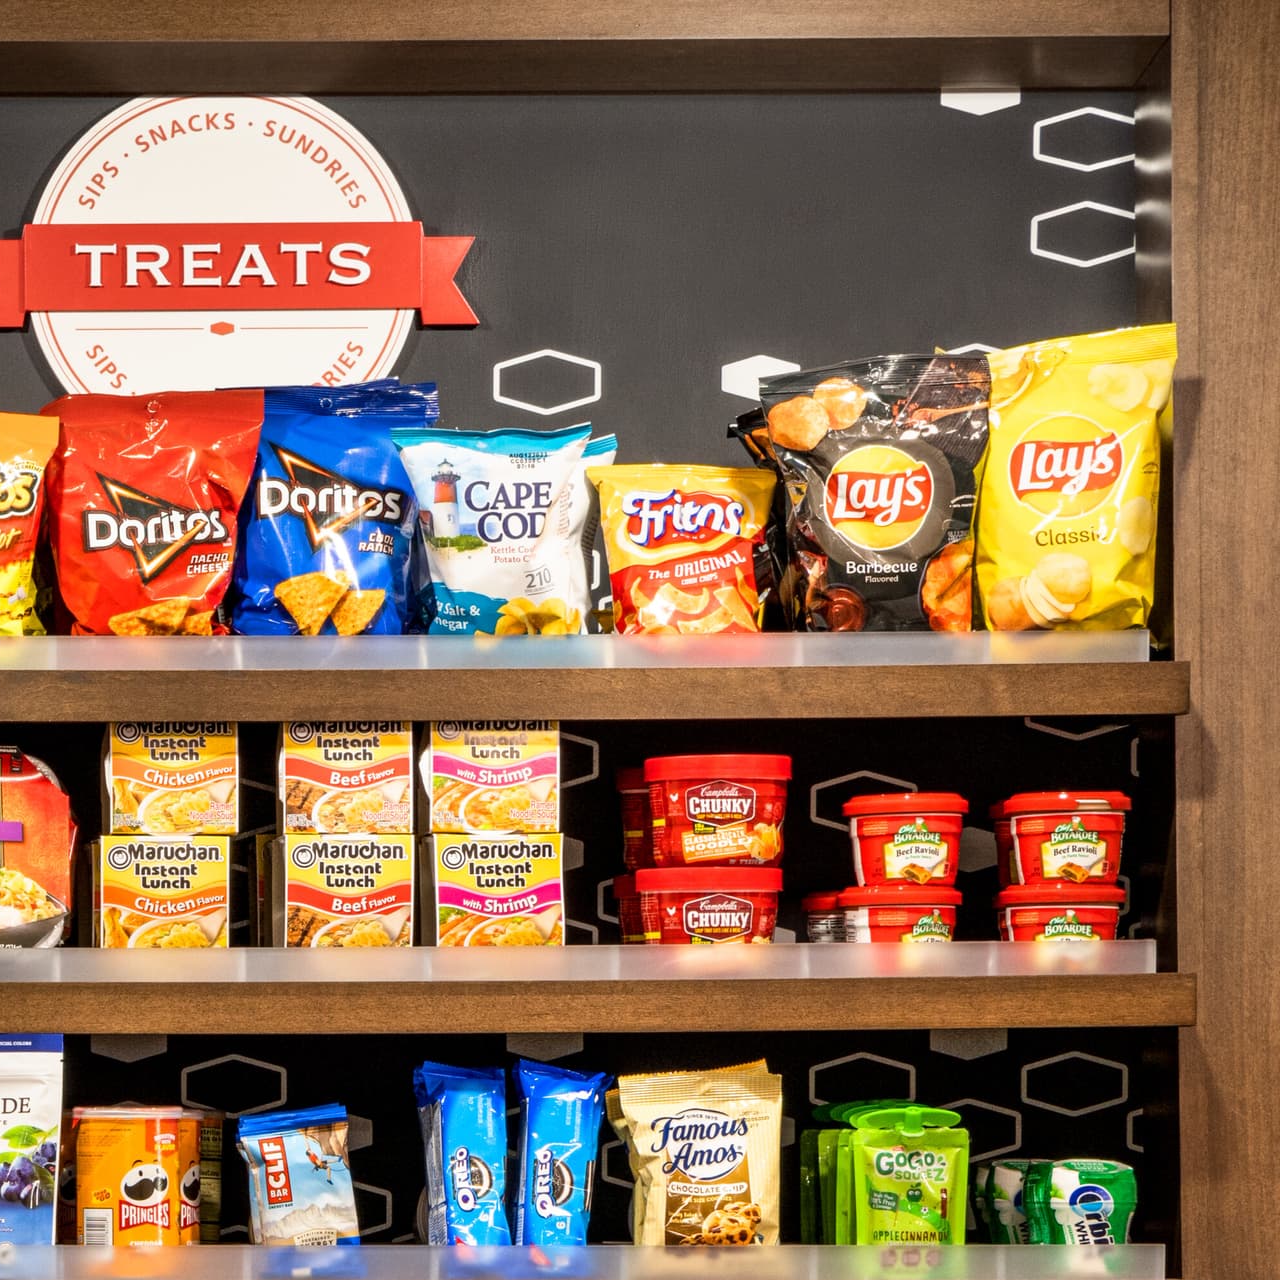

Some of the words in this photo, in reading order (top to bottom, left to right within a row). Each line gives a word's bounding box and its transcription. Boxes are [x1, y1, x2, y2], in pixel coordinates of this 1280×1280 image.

[78, 160, 120, 210] SIPS
[134, 112, 237, 154] SNACKS
[262, 119, 367, 210] SUNDRIES
[74, 241, 373, 288] TREATS
[85, 343, 124, 389] SIPS
[1018, 437, 1118, 496] Lay's
[258, 479, 402, 521] Doritos
[464, 481, 552, 512] CAPE
[832, 468, 927, 527] Lay's
[622, 490, 744, 546] Fritos
[86, 509, 229, 549] Doritos
[477, 512, 547, 543] COD
[358, 541, 394, 555] RANCH
[191, 553, 229, 564] NACHO
[674, 550, 747, 577] ORIGINAL
[187, 563, 230, 574] CHEESE
[846, 561, 918, 575] Barbecue
[525, 568, 552, 589] 210
[865, 575, 899, 584] Flavored
[443, 603, 466, 616] Salt
[143, 736, 207, 750] Instant
[317, 736, 380, 749] Instant
[464, 733, 528, 747] Instant
[150, 749, 200, 761] Lunch
[324, 749, 373, 761] Lunch
[471, 746, 521, 759] Lunch
[143, 768, 205, 787] Chicken
[205, 765, 233, 779] Flavor
[330, 771, 367, 786] Beef
[367, 767, 395, 781] Flavor
[457, 768, 476, 780] with
[478, 765, 533, 785] Shrimp
[689, 797, 752, 815] CHUNKY
[129, 843, 222, 861] Maruchan
[312, 842, 404, 858] Maruchan
[462, 842, 553, 858] Maruchan
[896, 847, 913, 857] Beef
[915, 846, 939, 857] Ravioli
[1054, 846, 1070, 856] Beef
[1072, 845, 1097, 855] Ravioli
[135, 863, 198, 877] Instant
[319, 862, 382, 875] Instant
[469, 862, 532, 875] Instant
[141, 877, 191, 889] Lunch
[326, 875, 375, 888] Lunch
[476, 875, 525, 888] Lunch
[134, 896, 196, 914] Chicken
[196, 894, 224, 906] Flavor
[332, 897, 367, 912] Beef
[368, 894, 397, 908] Flavor
[463, 898, 482, 910] with
[483, 894, 538, 913] Shrimp
[687, 910, 750, 928] CHUNKY
[650, 1115, 749, 1153] Famous
[262, 1142, 287, 1189] CLIF
[662, 1143, 744, 1174] Amos
[451, 1147, 477, 1211] OREO
[536, 1150, 554, 1217] OREO
[270, 1188, 289, 1198] BAR
[671, 1184, 721, 1194] CHOCOLATE
[121, 1202, 169, 1228] PRINGLES
